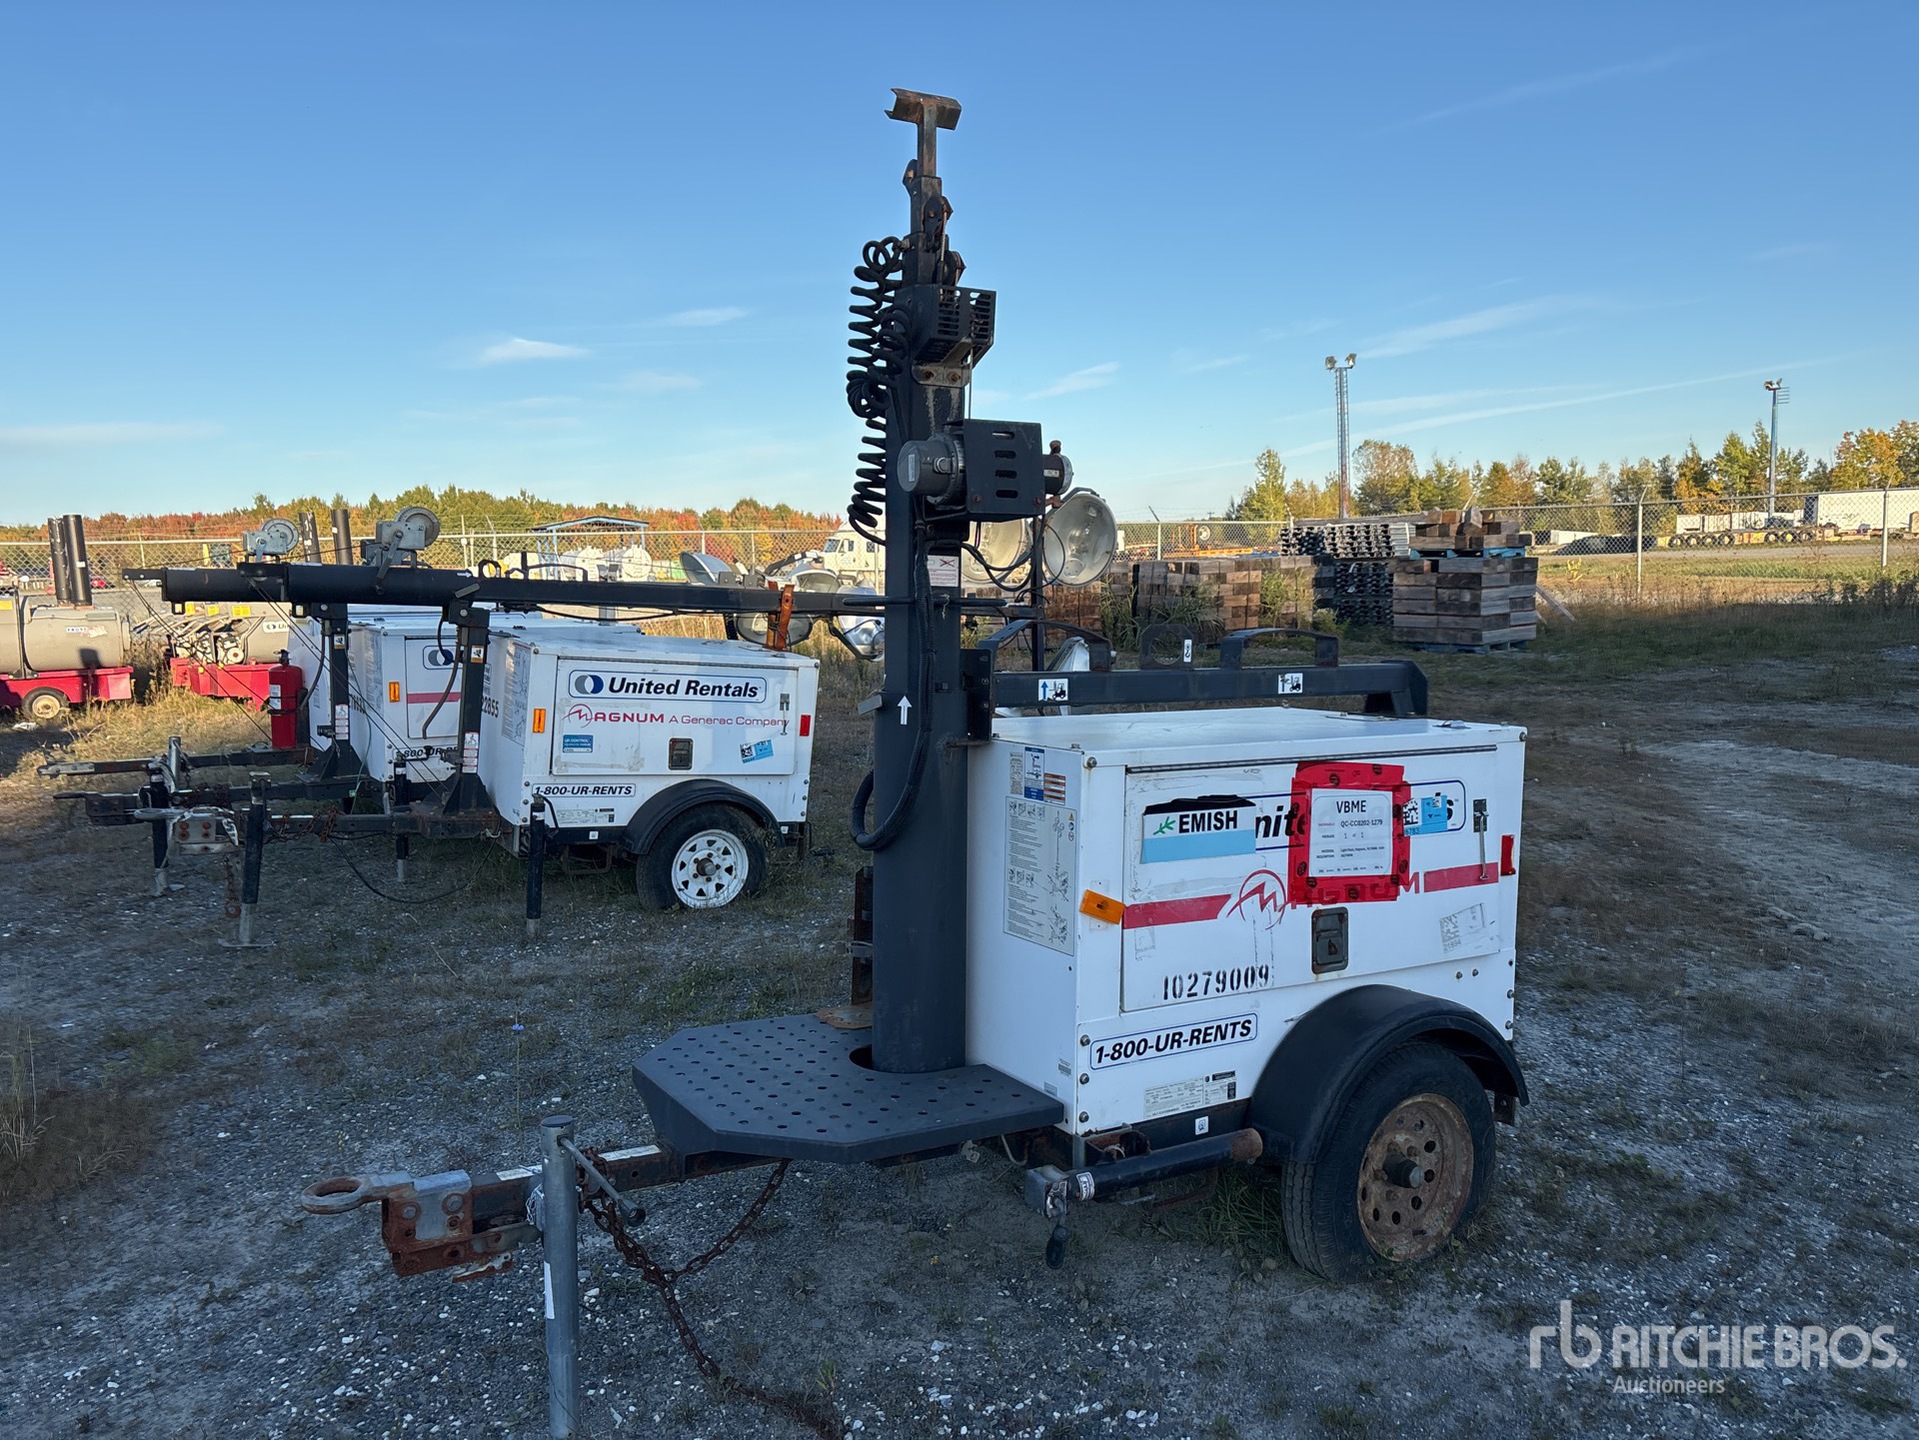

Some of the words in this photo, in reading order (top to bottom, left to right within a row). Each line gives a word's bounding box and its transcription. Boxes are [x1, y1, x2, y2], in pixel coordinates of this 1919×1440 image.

[608, 676, 680, 696] United
[685, 680, 759, 698] Rentals
[669, 716, 679, 724] A
[681, 715, 733, 726] Generac
[735, 716, 790, 728] Company
[534, 785, 633, 796] 1-800-UR-RENTS
[1336, 800, 1367, 814] VBME
[1178, 810, 1238, 834] EMISH
[1162, 964, 1270, 1001] 10279009
[1095, 1019, 1252, 1064] 1-800-UR-RENTS
